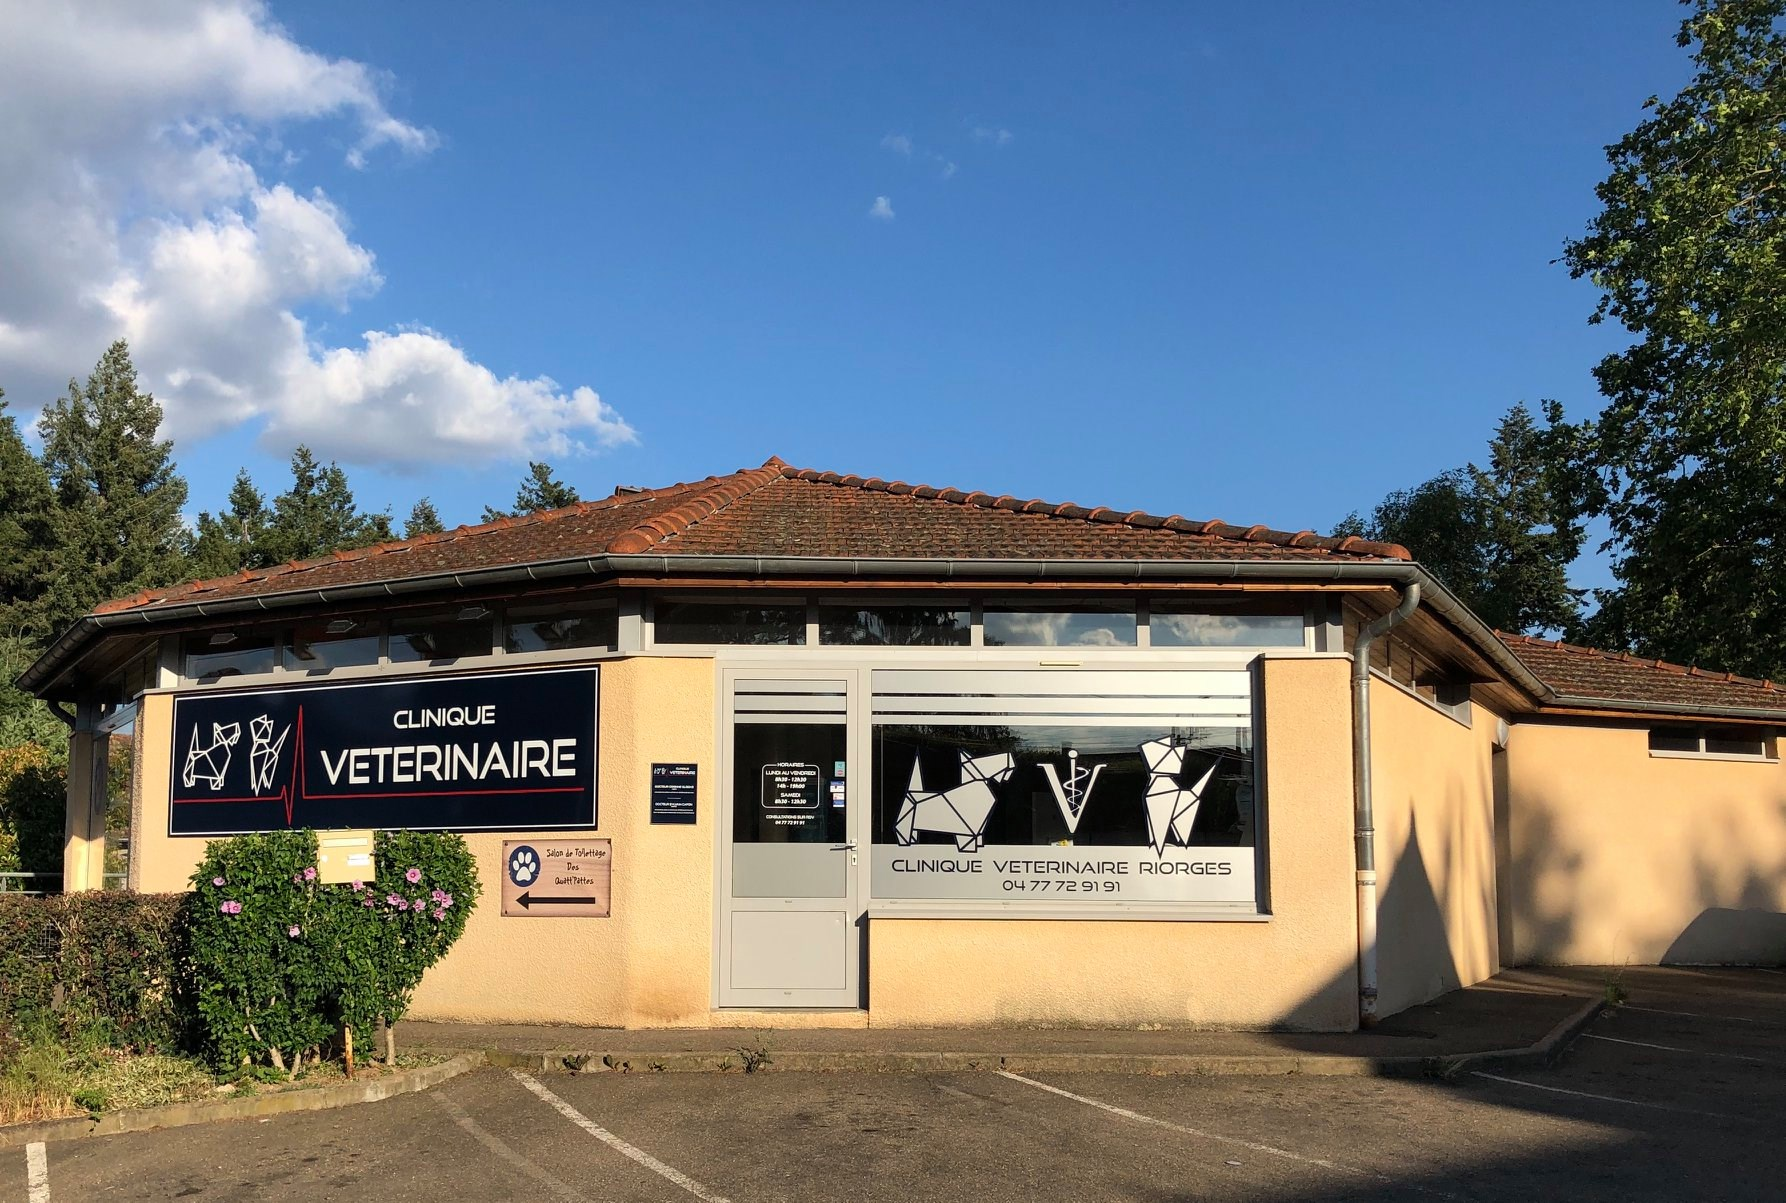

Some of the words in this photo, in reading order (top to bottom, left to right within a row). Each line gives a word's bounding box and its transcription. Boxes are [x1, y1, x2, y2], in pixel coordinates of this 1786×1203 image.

[393, 705, 496, 729] CLINIQUE
[320, 738, 577, 785] VETERINAIRE
[546, 848, 564, 858] Salon
[565, 848, 573, 858] de
[574, 848, 606, 859] Toilettage
[567, 862, 580, 871] Des
[891, 859, 983, 874] CLINIQUE
[993, 860, 1129, 875] VETERINAIRE
[1139, 861, 1232, 876] RIORGES
[1002, 879, 1026, 892] 04
[1030, 880, 1051, 892] 77
[1055, 880, 1077, 893] 72
[1082, 880, 1099, 893] 91
[1104, 880, 1121, 893] 91
